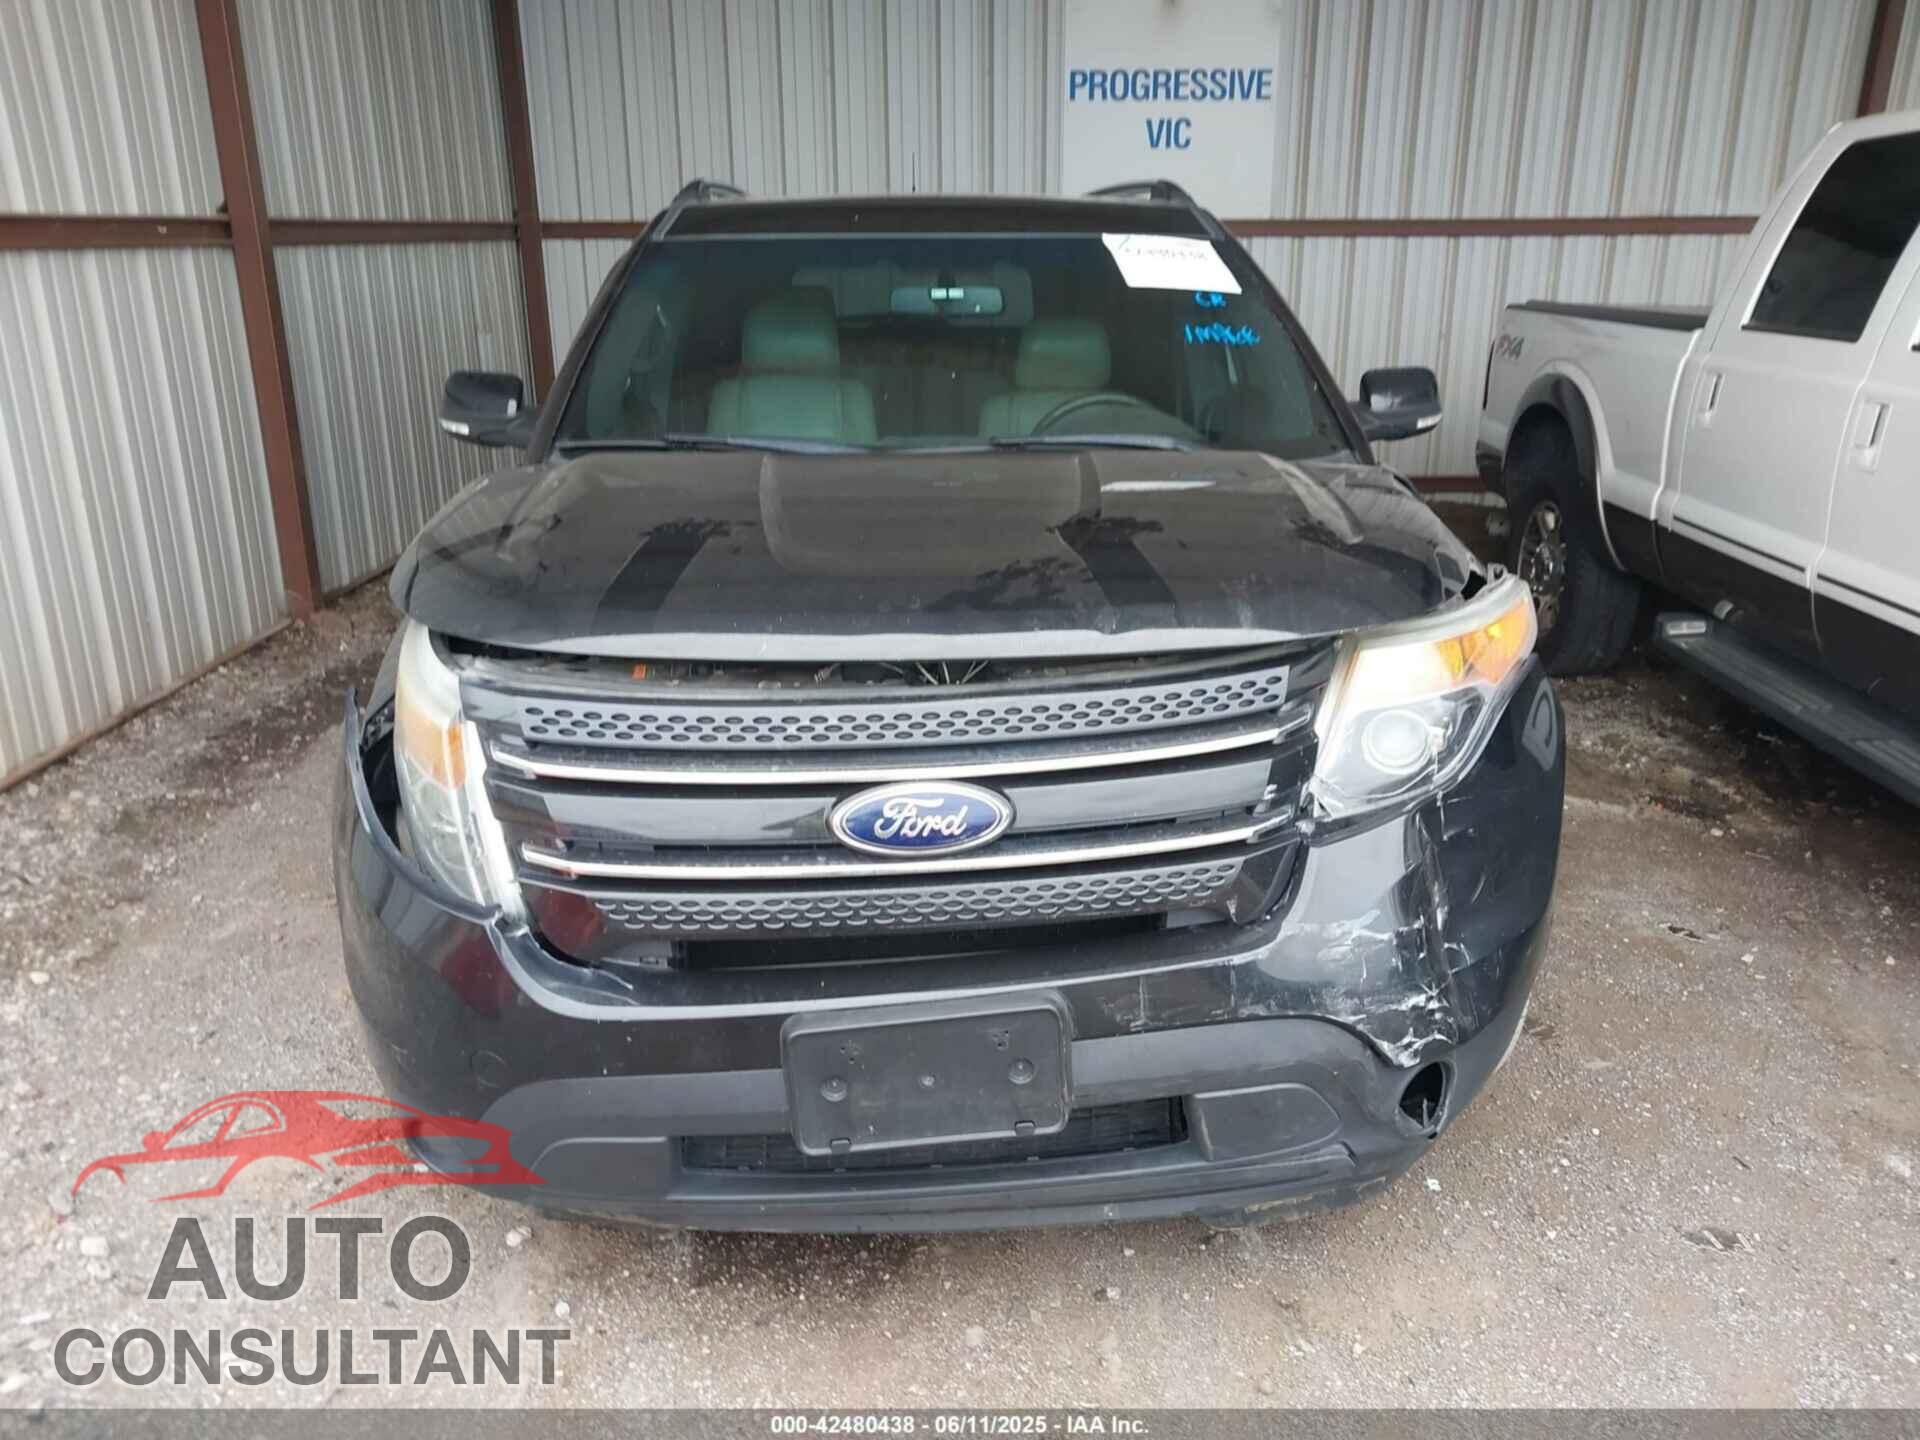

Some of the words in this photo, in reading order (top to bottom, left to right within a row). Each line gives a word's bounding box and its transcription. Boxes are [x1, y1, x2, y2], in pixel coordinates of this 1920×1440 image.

[1069, 68, 1273, 101] PROGRESSIVE
[1146, 117, 1192, 149] VIC
[874, 797, 969, 839] Ford
